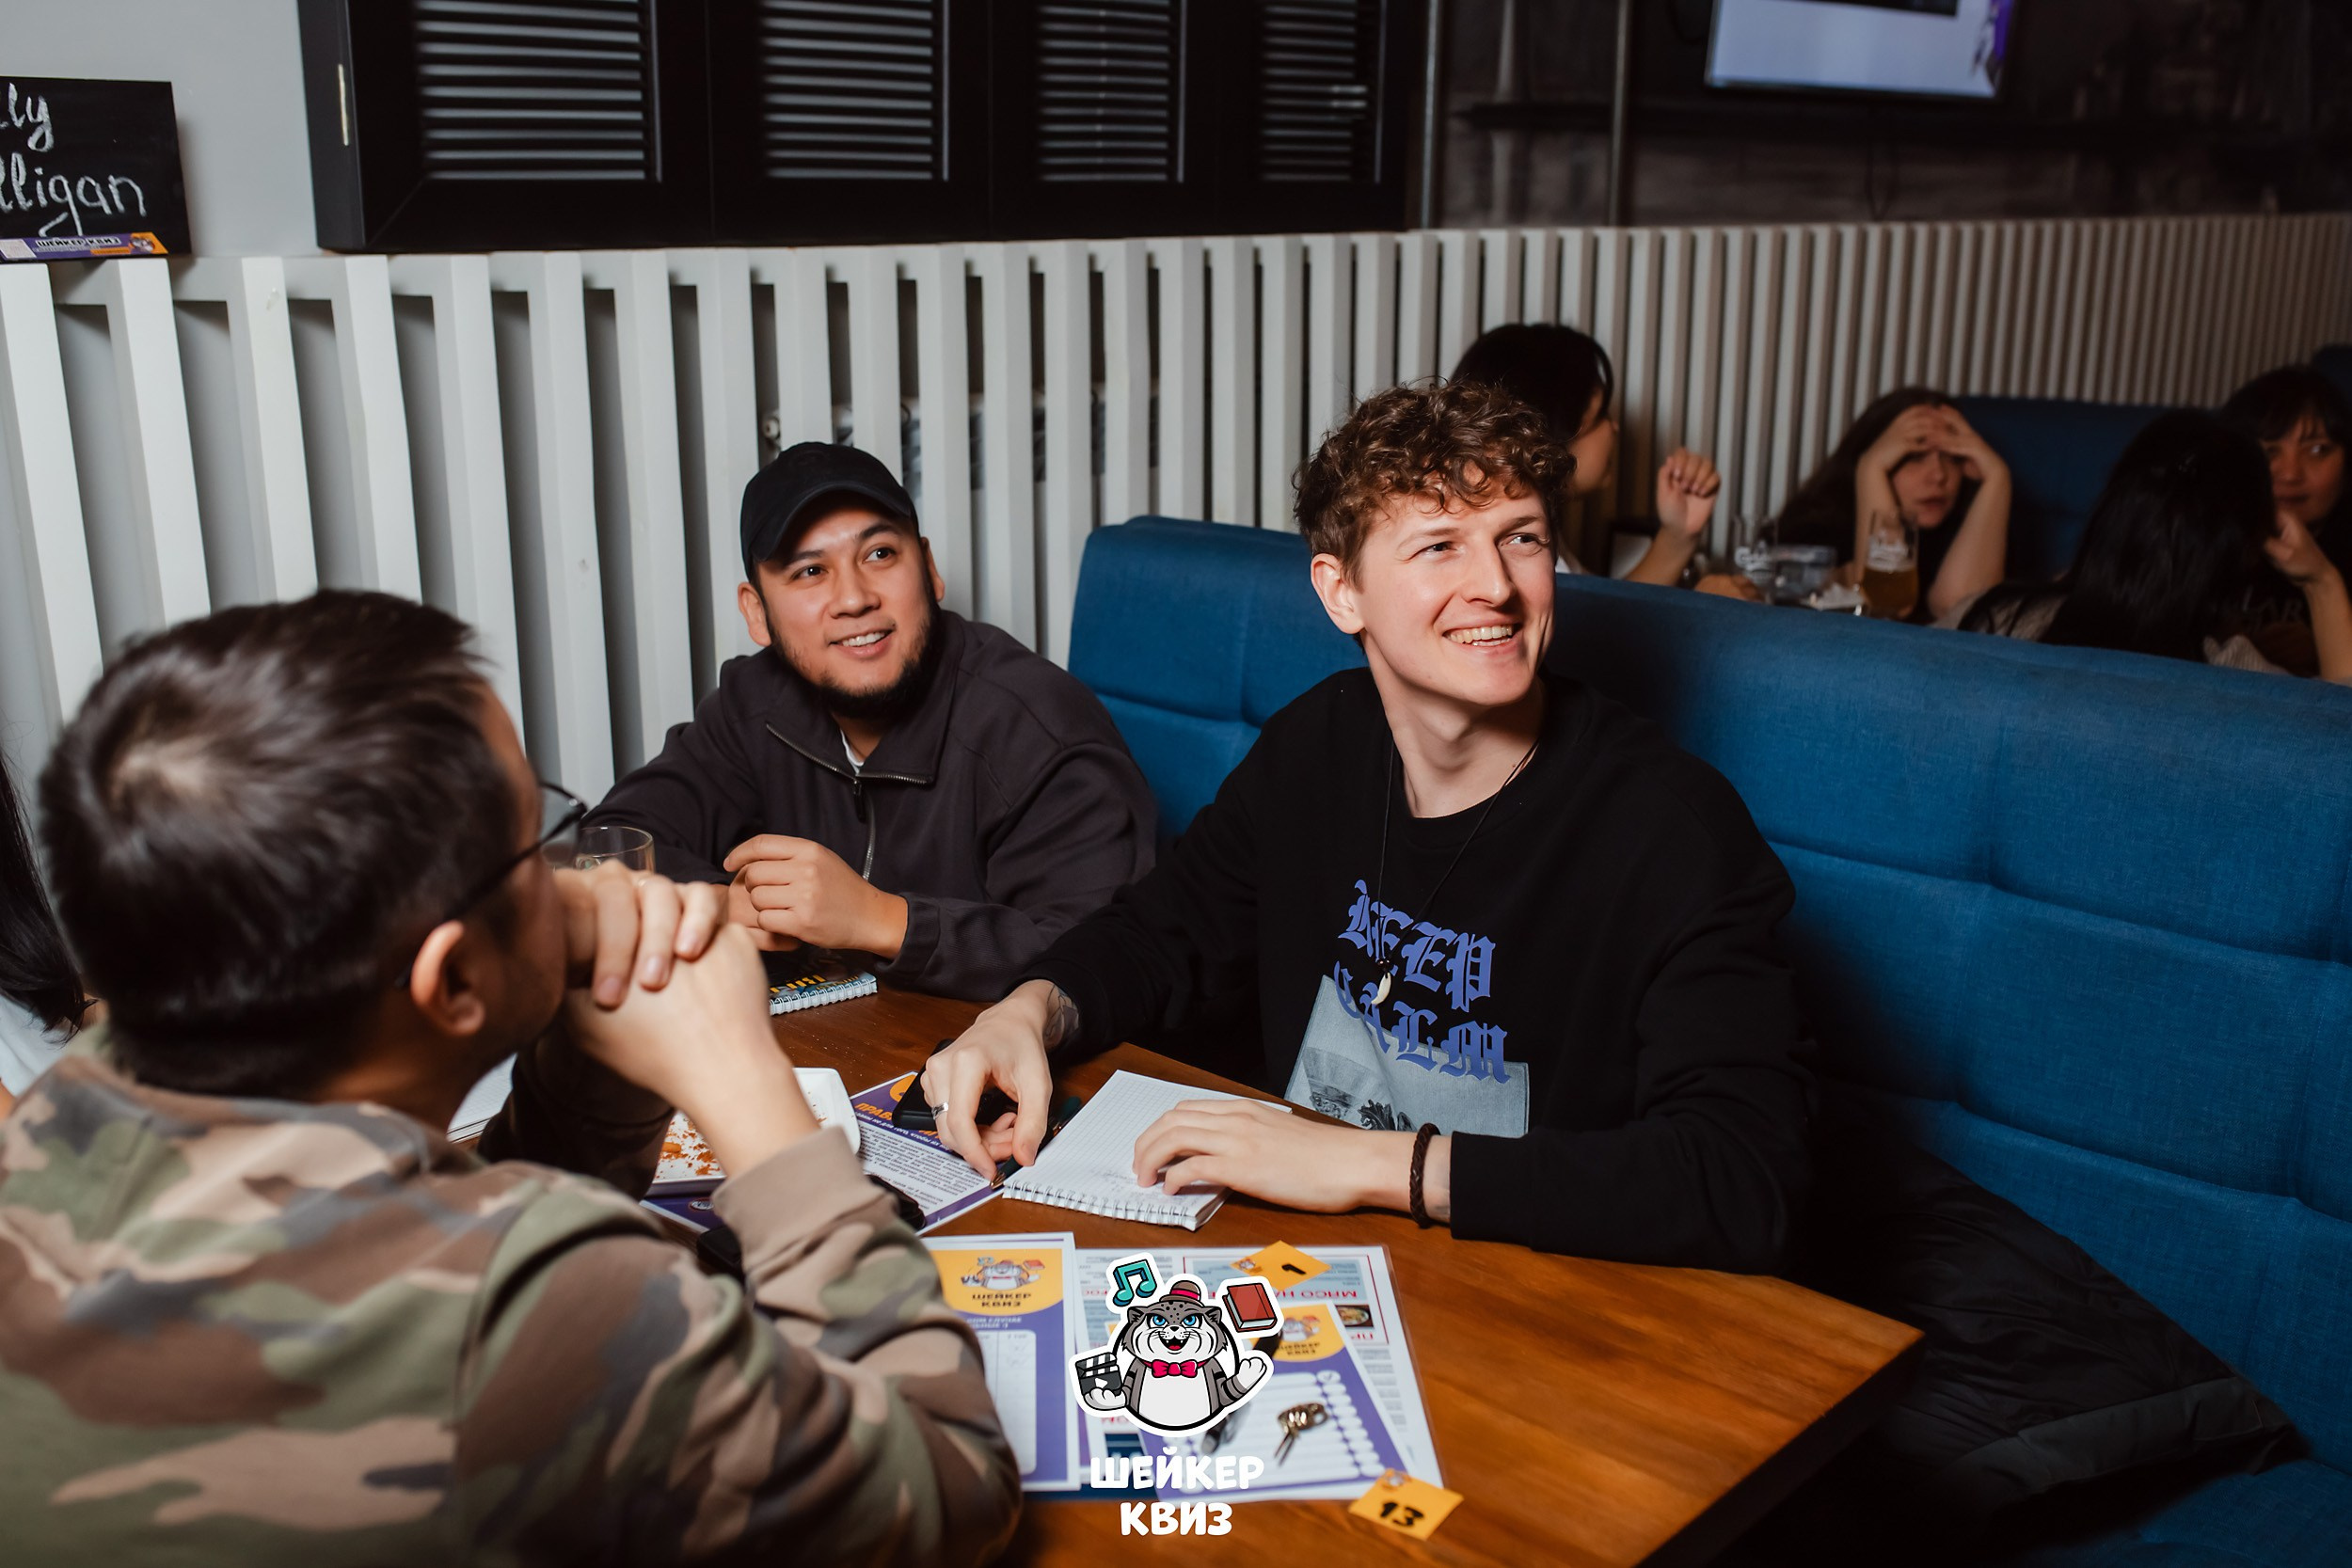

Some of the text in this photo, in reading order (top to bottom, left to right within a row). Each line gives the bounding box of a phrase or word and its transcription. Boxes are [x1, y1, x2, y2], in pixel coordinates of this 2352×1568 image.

[0, 82, 55, 151] ly
[36, 237, 85, 247] ШЕЙКЕР
[1333, 960, 1511, 1084] CALM
[854, 1102, 892, 1120] ПРАВ
[1379, 1500, 1425, 1528] 13
